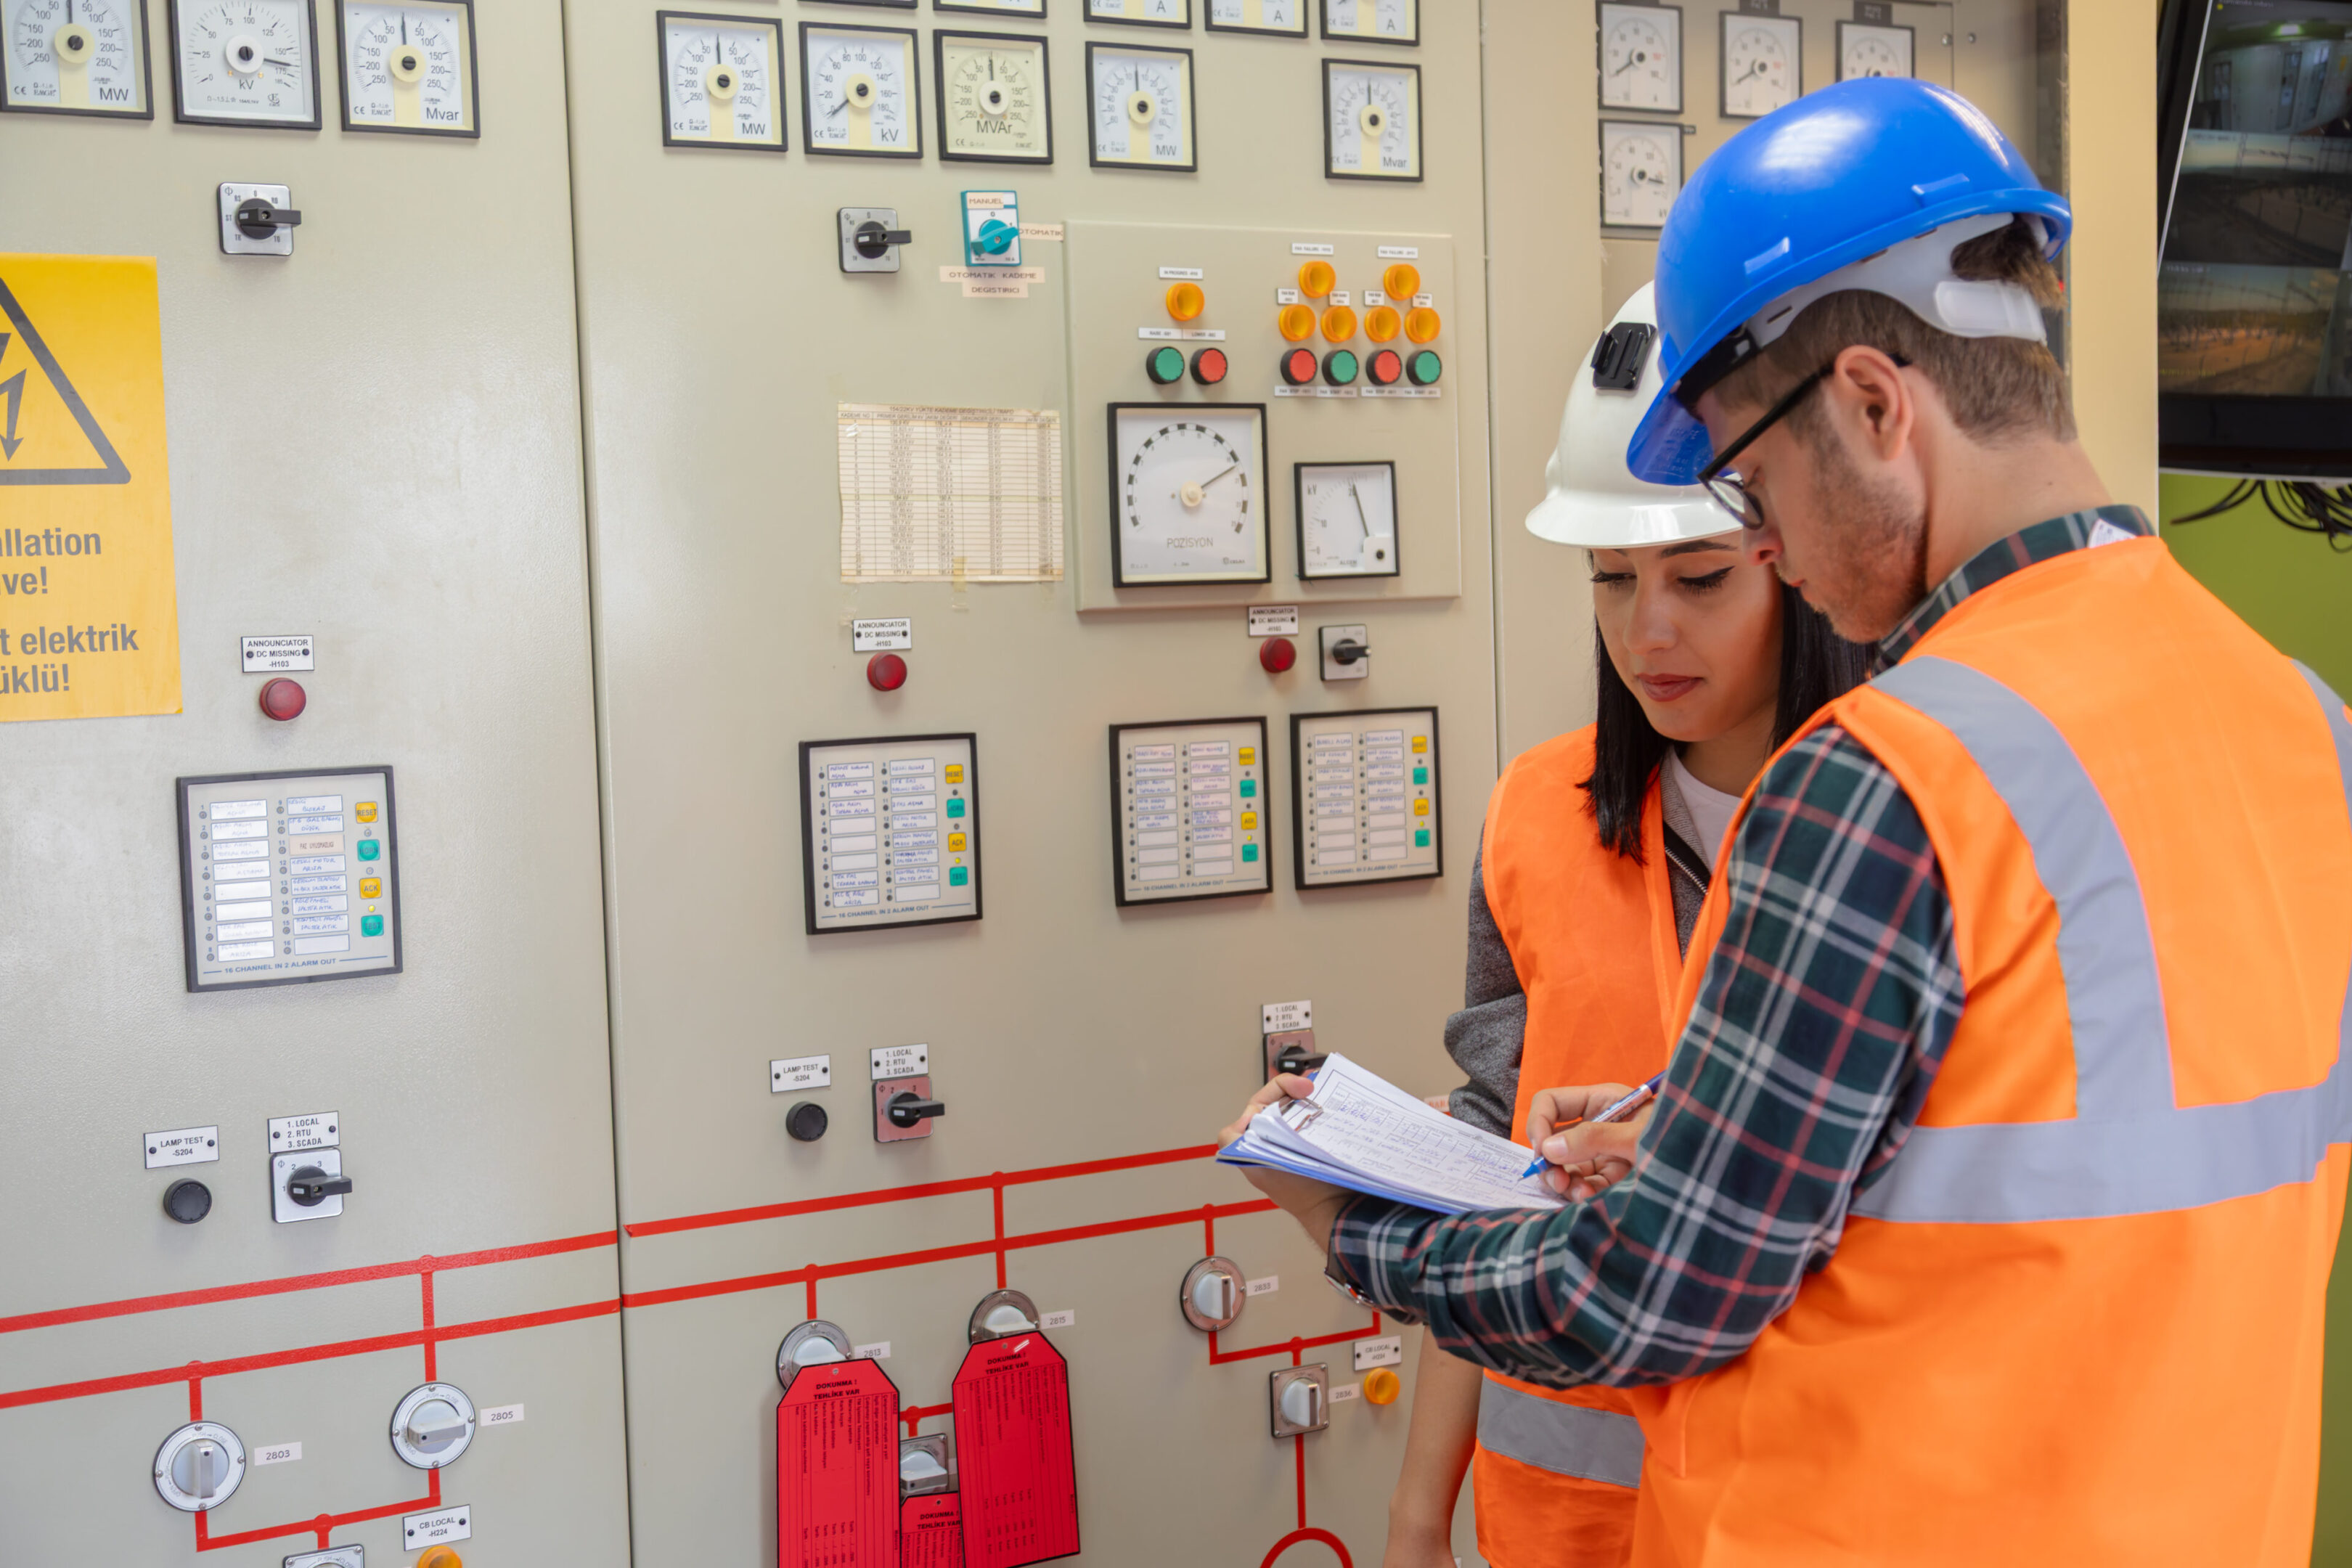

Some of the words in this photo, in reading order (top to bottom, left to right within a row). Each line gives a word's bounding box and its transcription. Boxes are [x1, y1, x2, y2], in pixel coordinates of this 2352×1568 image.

[49, 1, 59, 10] 50
[82, 3, 93, 12] 50
[1156, 1, 1166, 12] A
[36, 10, 51, 20] 100
[89, 14, 104, 23] 100
[1274, 10, 1283, 22] A
[28, 25, 44, 33] 150
[1387, 19, 1395, 30] A
[98, 28, 113, 38] 150
[385, 25, 395, 35] 50
[415, 28, 425, 36] 50
[27, 38, 43, 48] 200
[374, 35, 388, 44] 100
[421, 38, 435, 46] 100
[100, 43, 115, 52] 200
[367, 48, 380, 57] 150
[702, 46, 711, 54] 50
[729, 47, 738, 56] 50
[34, 53, 50, 62] 250
[96, 57, 112, 68] 250
[691, 54, 704, 63] 100
[734, 57, 746, 65] 100
[366, 62, 380, 70] 200
[430, 65, 445, 74] 200
[686, 67, 698, 75] 150
[372, 75, 386, 83] 250
[427, 79, 441, 88] 250
[239, 80, 254, 90] kV
[743, 83, 756, 91] 200
[99, 87, 128, 101] MW
[690, 92, 703, 101] 250
[739, 96, 753, 105] 250
[426, 107, 459, 121] Mvar
[742, 123, 766, 135] MW
[976, 120, 1013, 134] MVAr
[881, 128, 899, 143] kV
[1156, 145, 1177, 156] MW
[1383, 157, 1408, 169] Mvar
[0, 528, 102, 557] llation
[1167, 536, 1214, 548] POZİSYON
[20, 624, 139, 656] elektrik
[235, 964, 273, 973] CHANNEL
[295, 1117, 319, 1127] LOCAL
[160, 1138, 182, 1148] LAMP
[184, 1136, 203, 1145] TEST
[297, 1138, 322, 1147] SCADA
[1049, 1315, 1066, 1325] 2815
[864, 1347, 881, 1357] 2813
[987, 1353, 1022, 1365] DOKUNMA
[985, 1365, 1015, 1375] TEHLİKE
[816, 1379, 852, 1389] DOKUNMA
[814, 1389, 844, 1400] TEHLİKE
[491, 1410, 513, 1421] 2805
[266, 1449, 290, 1460] 2803
[920, 1511, 954, 1520] DOKUNMA
[431, 1516, 455, 1527] LOCAL
[428, 1528, 447, 1538] -H224
